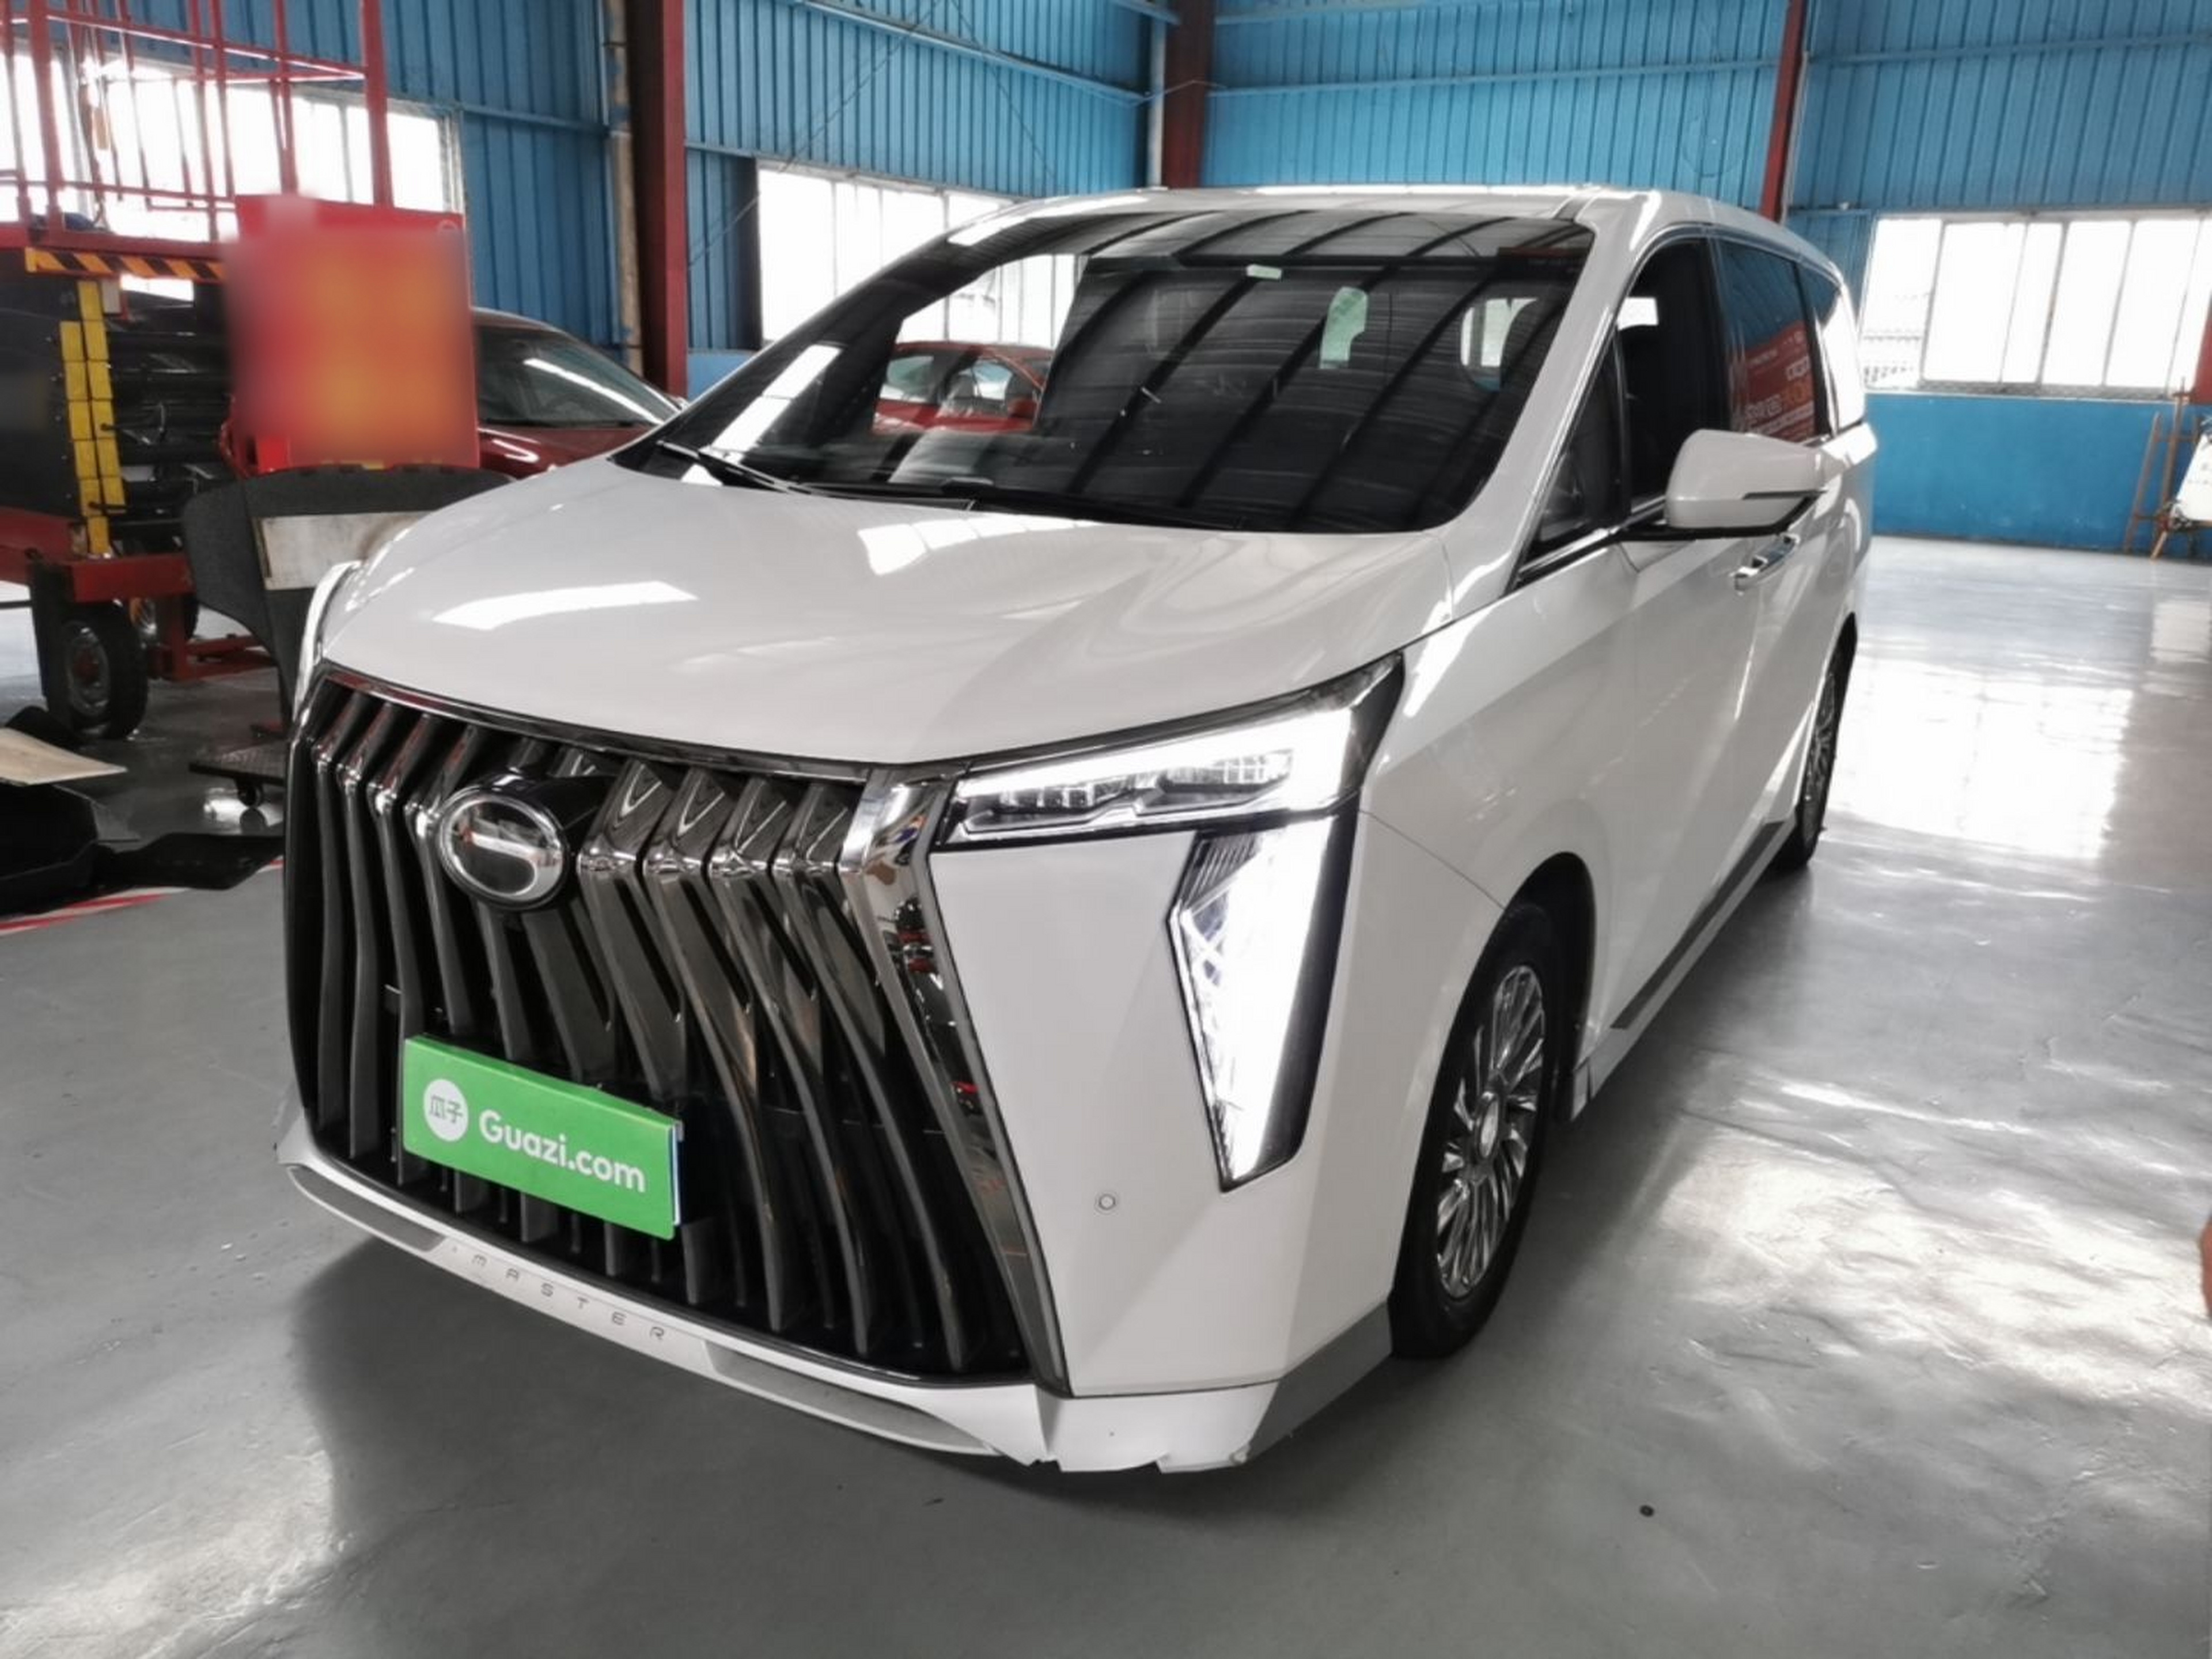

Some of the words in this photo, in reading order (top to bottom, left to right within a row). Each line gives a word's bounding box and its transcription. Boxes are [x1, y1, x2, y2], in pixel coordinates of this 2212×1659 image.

[429, 1094, 463, 1123] 瓜子
[479, 1109, 645, 1193] Guazi.com
[472, 1253, 665, 1340] MASTER
